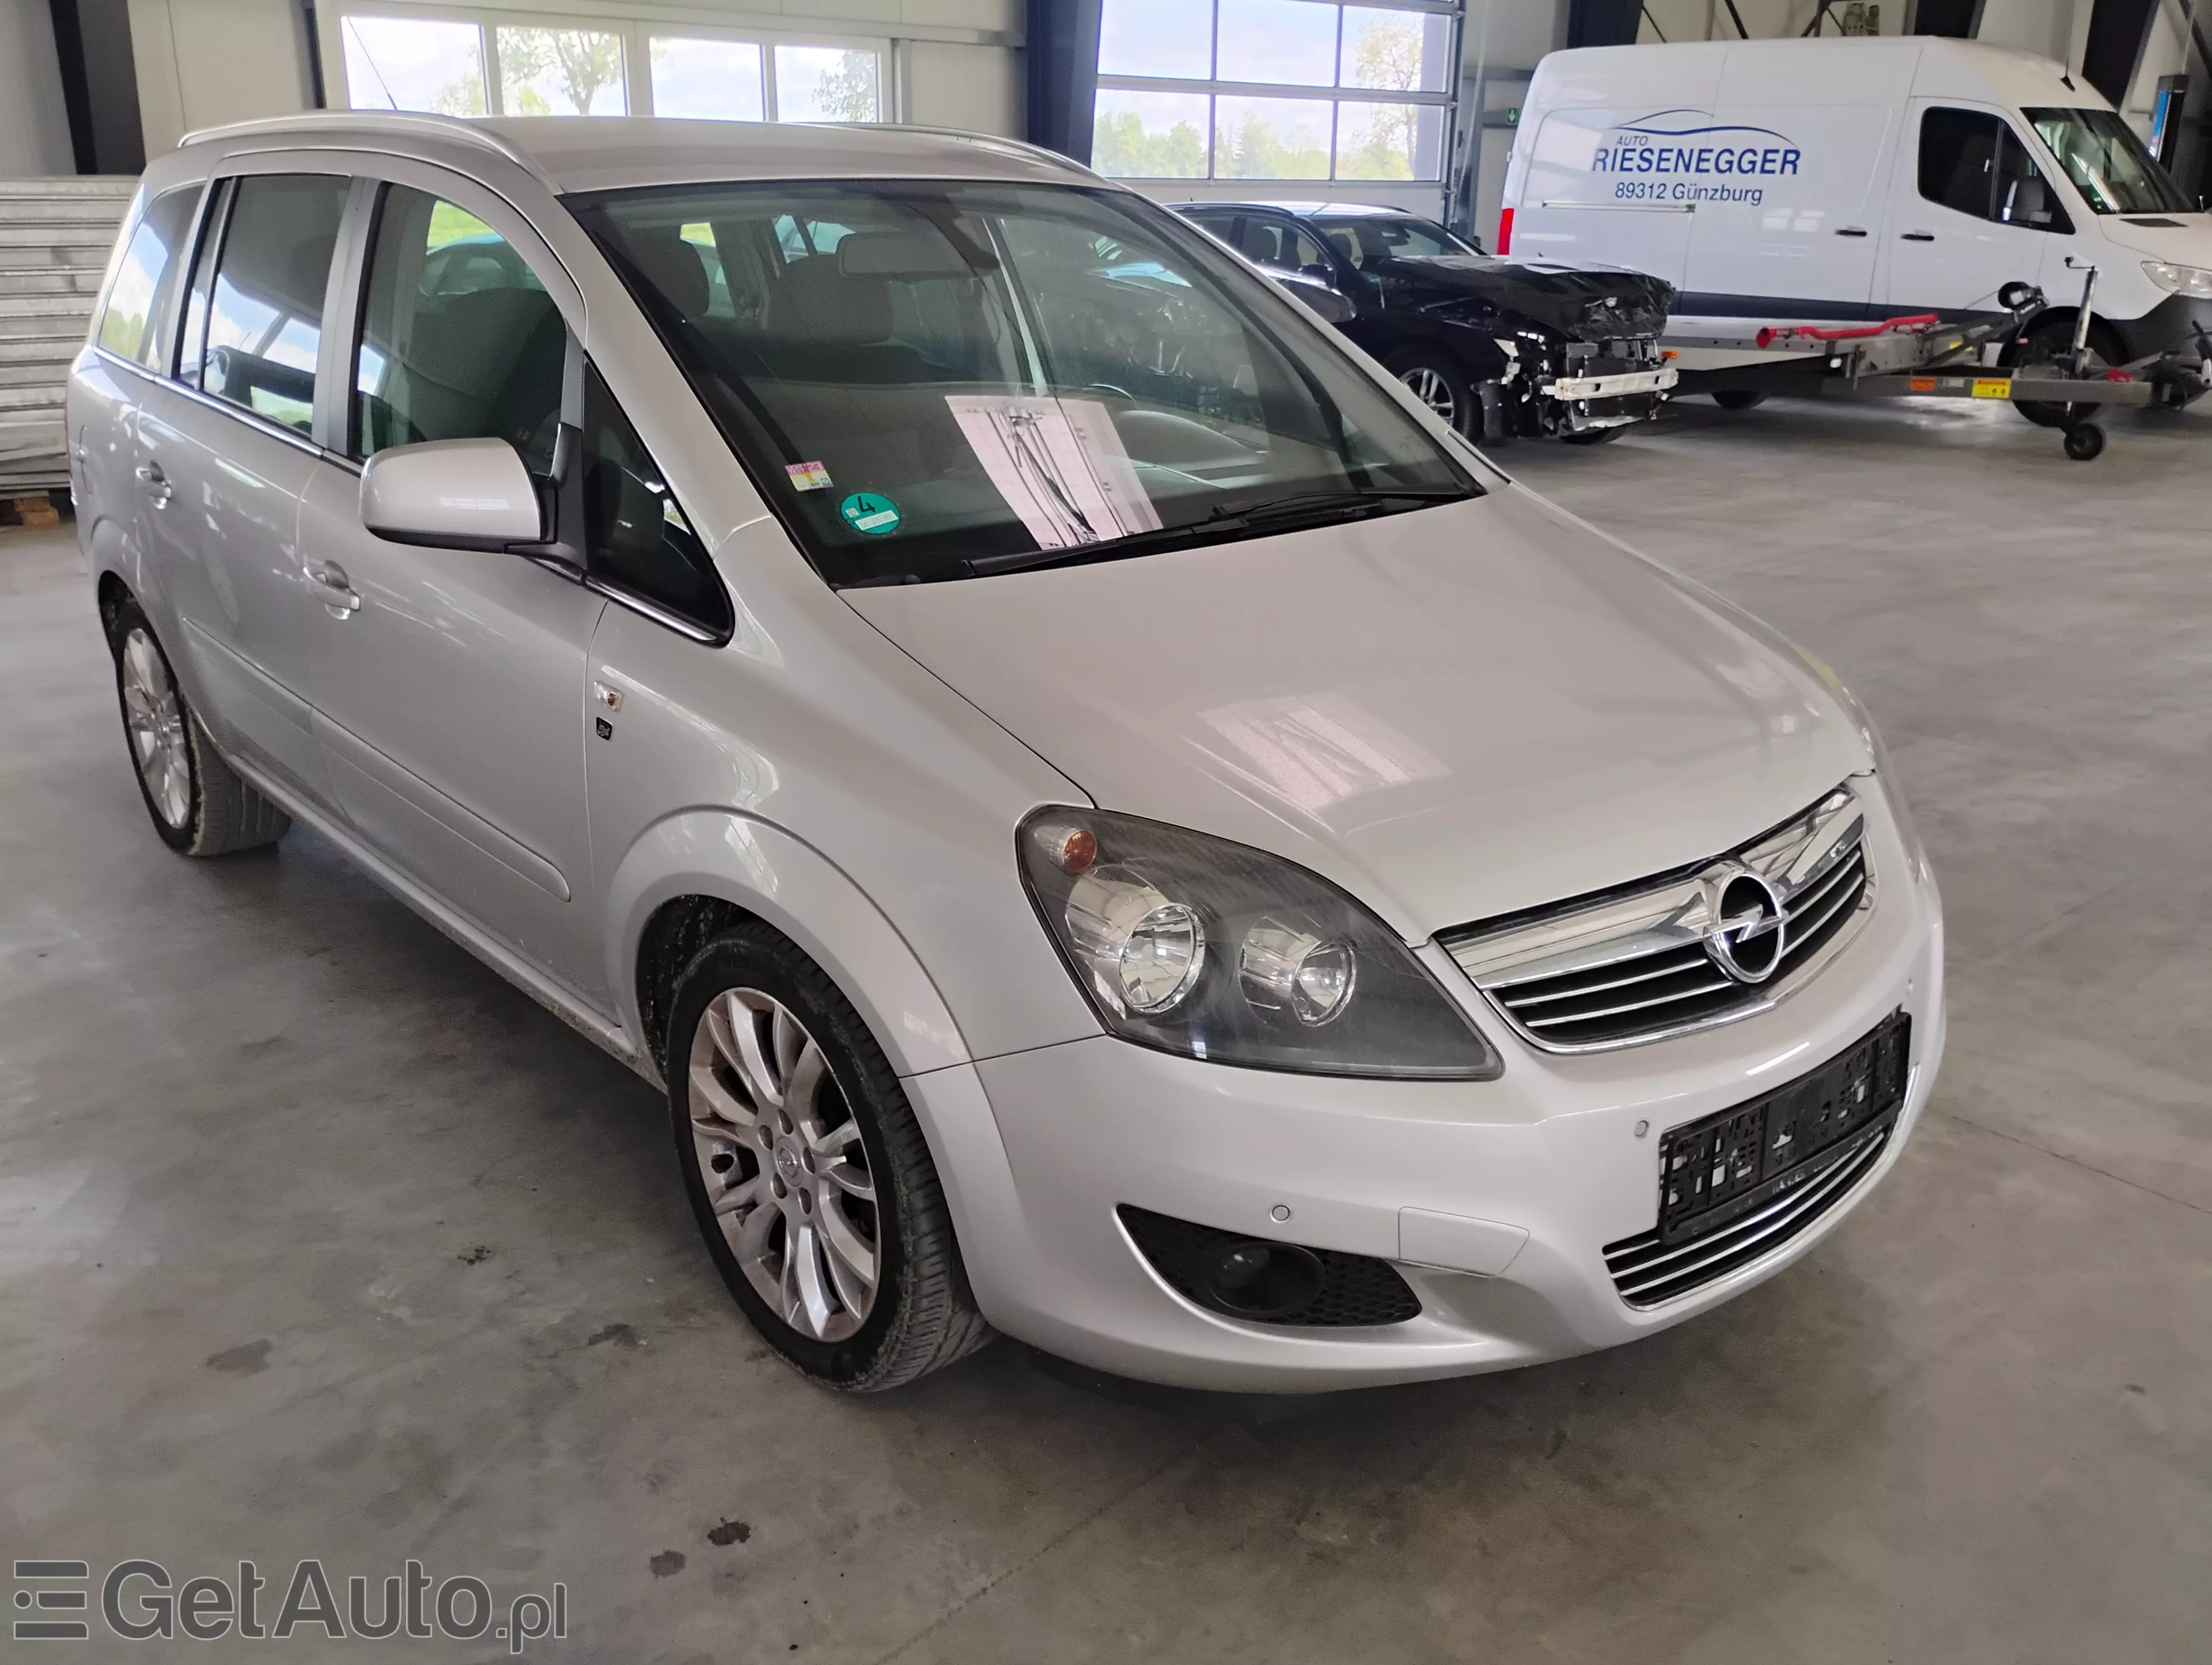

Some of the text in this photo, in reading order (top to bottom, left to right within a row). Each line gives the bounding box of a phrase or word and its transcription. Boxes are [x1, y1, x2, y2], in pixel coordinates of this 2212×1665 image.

[1616, 135, 1649, 146] AUTO
[1592, 148, 1801, 175] RIESENEGGER
[1615, 182, 1763, 206] 89312 Günzburg
[857, 495, 876, 512] 4
